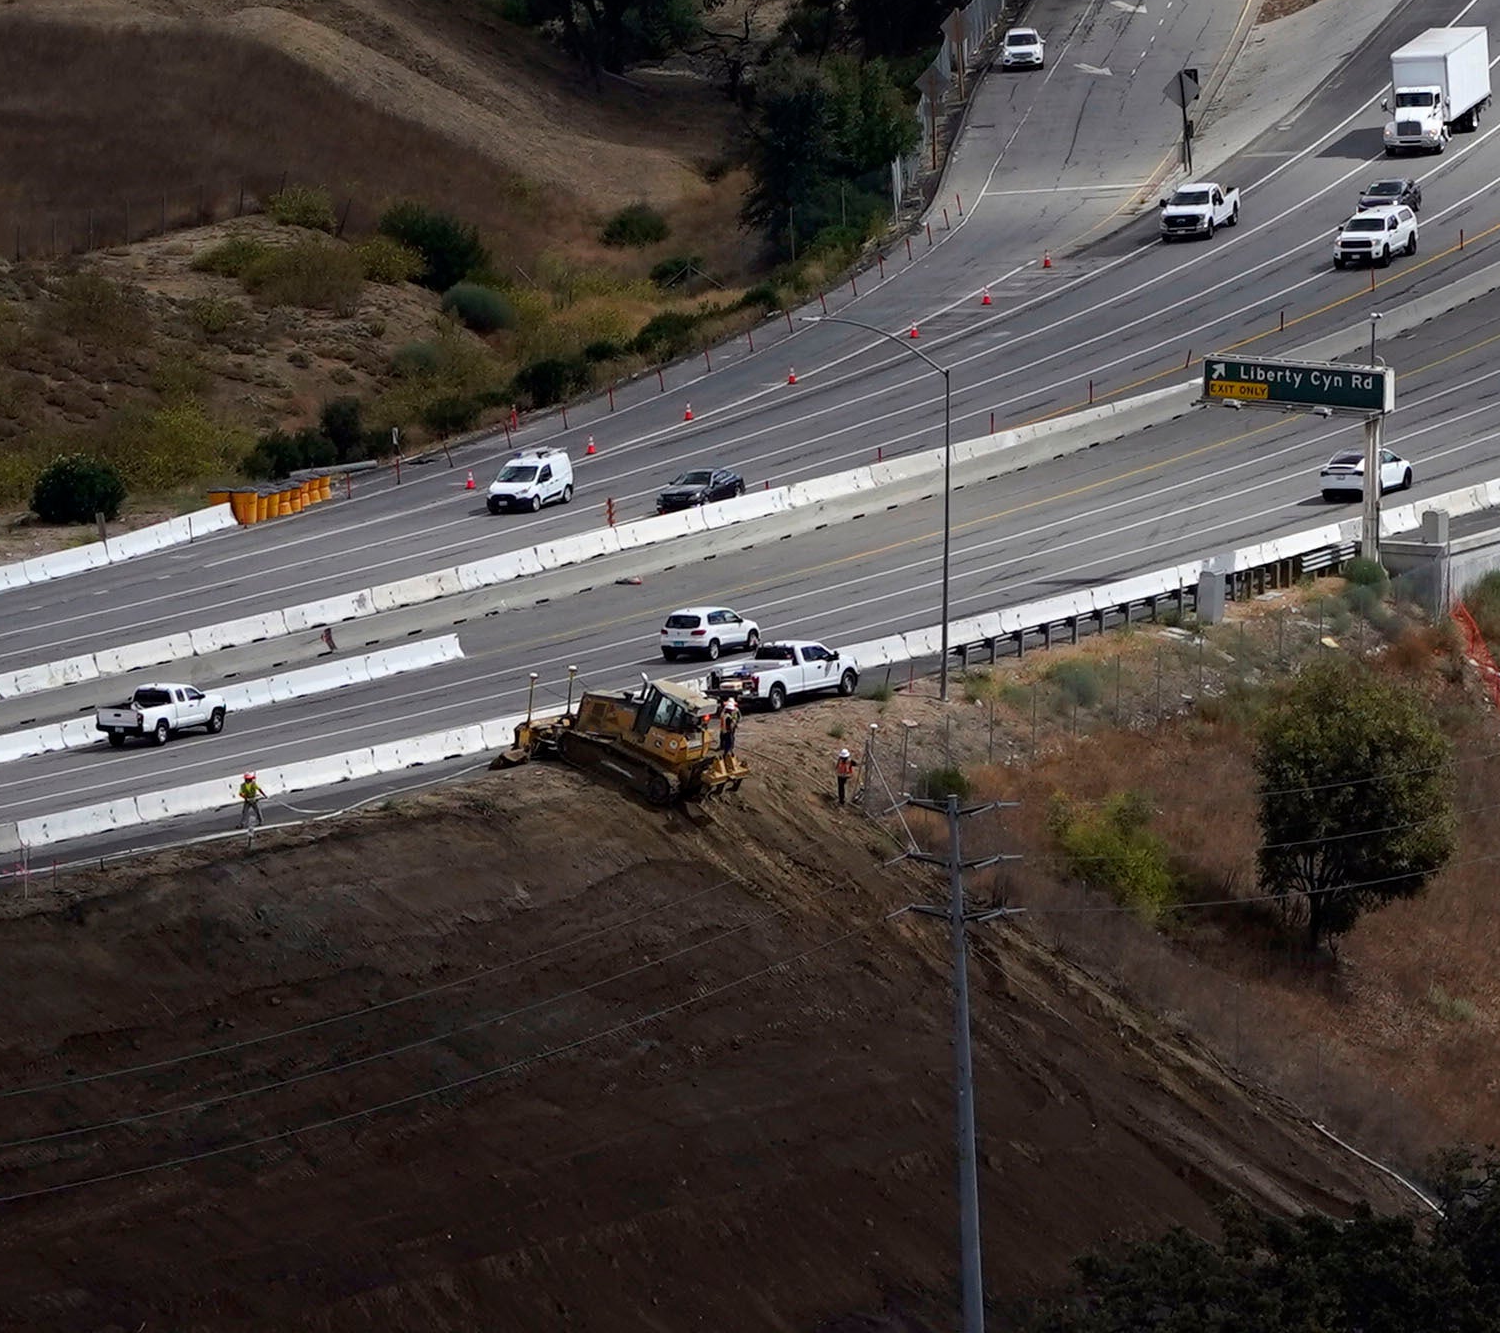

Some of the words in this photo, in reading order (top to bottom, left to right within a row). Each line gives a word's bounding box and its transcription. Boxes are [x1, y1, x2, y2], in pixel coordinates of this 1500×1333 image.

[1240, 365, 1303, 390] Liberty
[1310, 371, 1343, 391] Cyn
[1351, 374, 1373, 390] Rd
[1210, 384, 1235, 395] EXIT
[1239, 386, 1267, 397] ONLY
